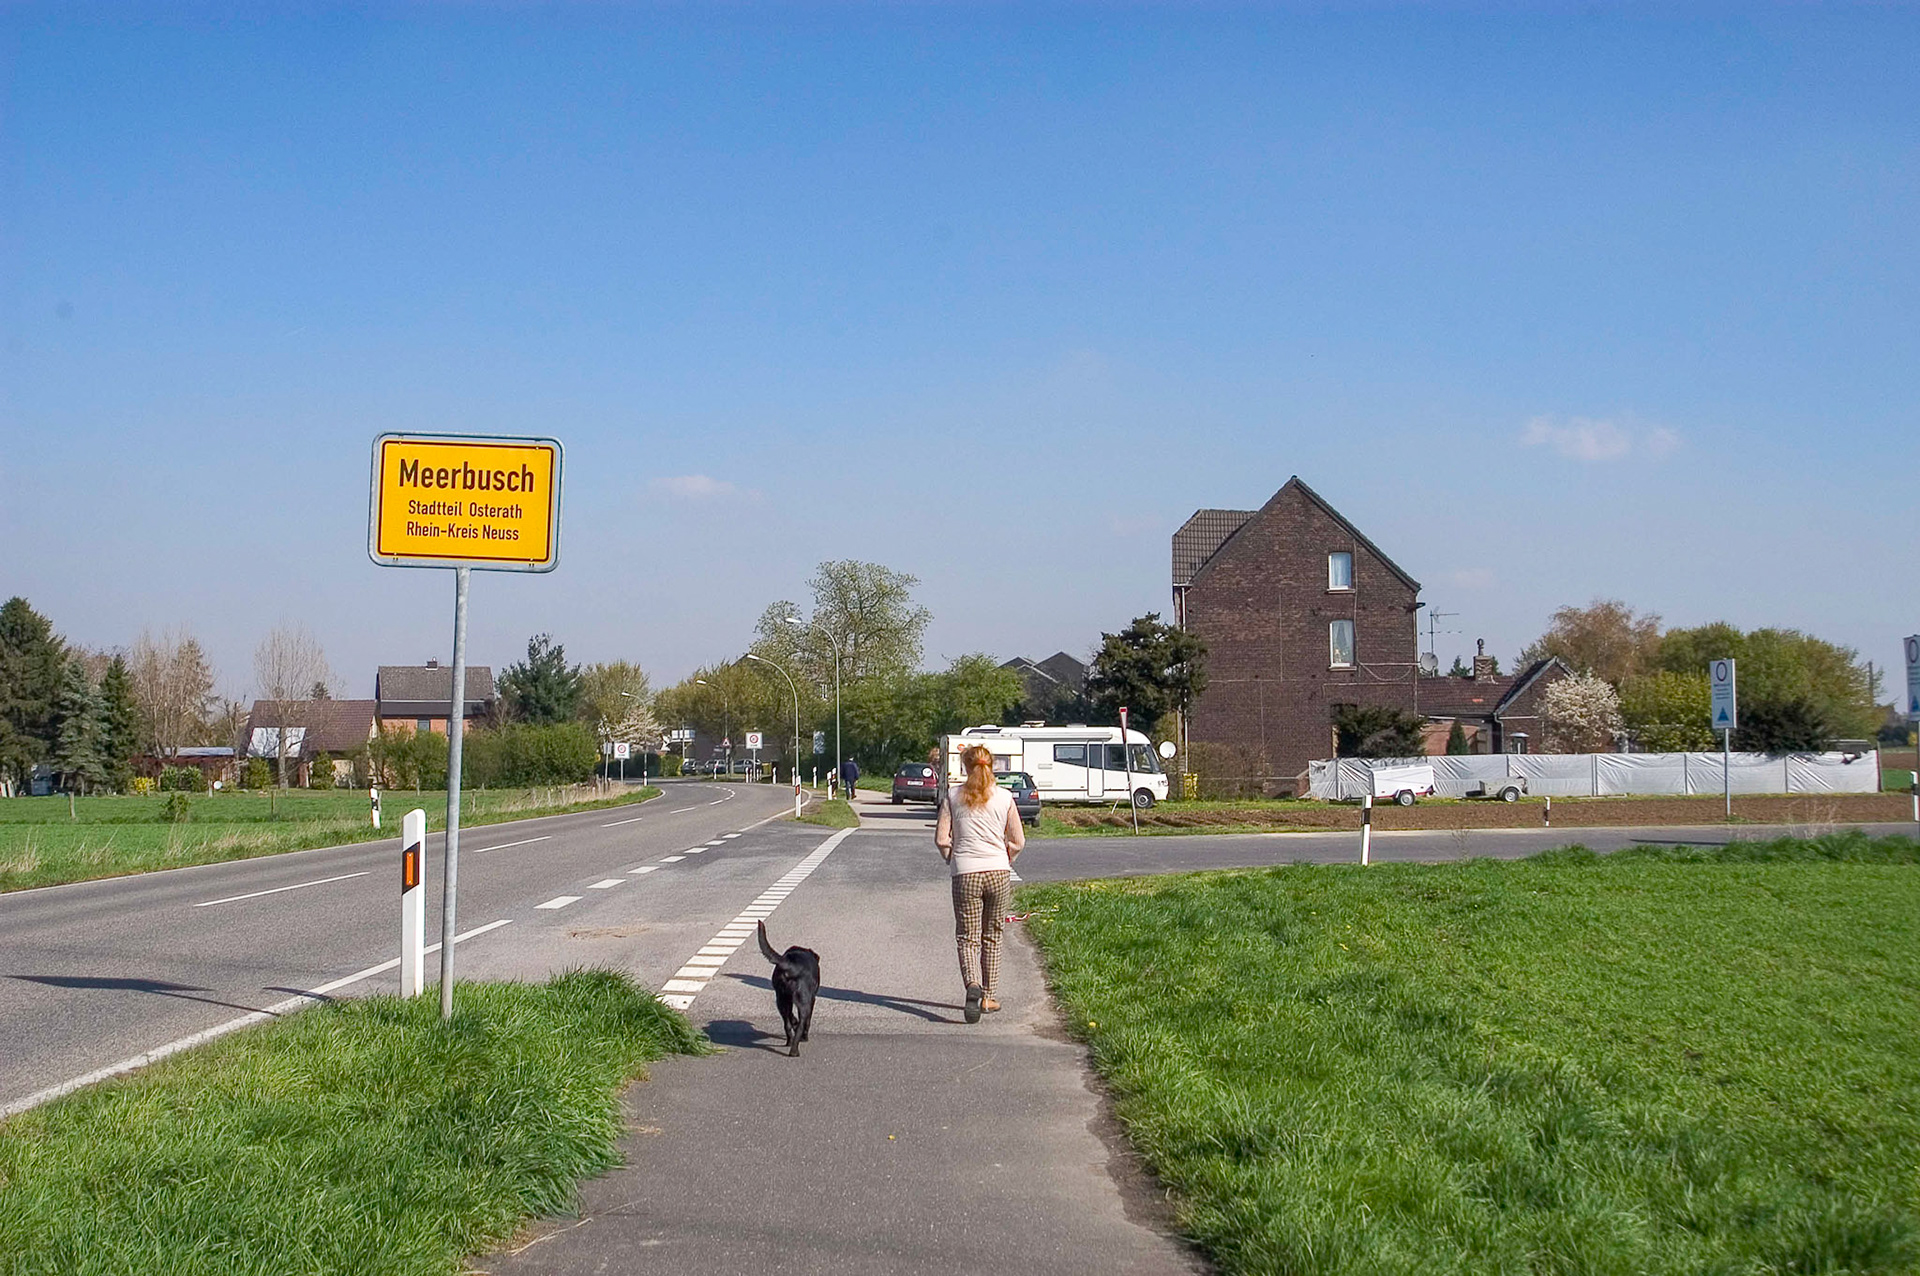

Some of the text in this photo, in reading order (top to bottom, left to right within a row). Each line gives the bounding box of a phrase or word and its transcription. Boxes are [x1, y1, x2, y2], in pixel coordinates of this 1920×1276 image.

[399, 458, 534, 492] Meerbusch
[408, 500, 522, 519] Stadtteil Osterath
[407, 521, 519, 541] Rhein-Kreis Neuss
